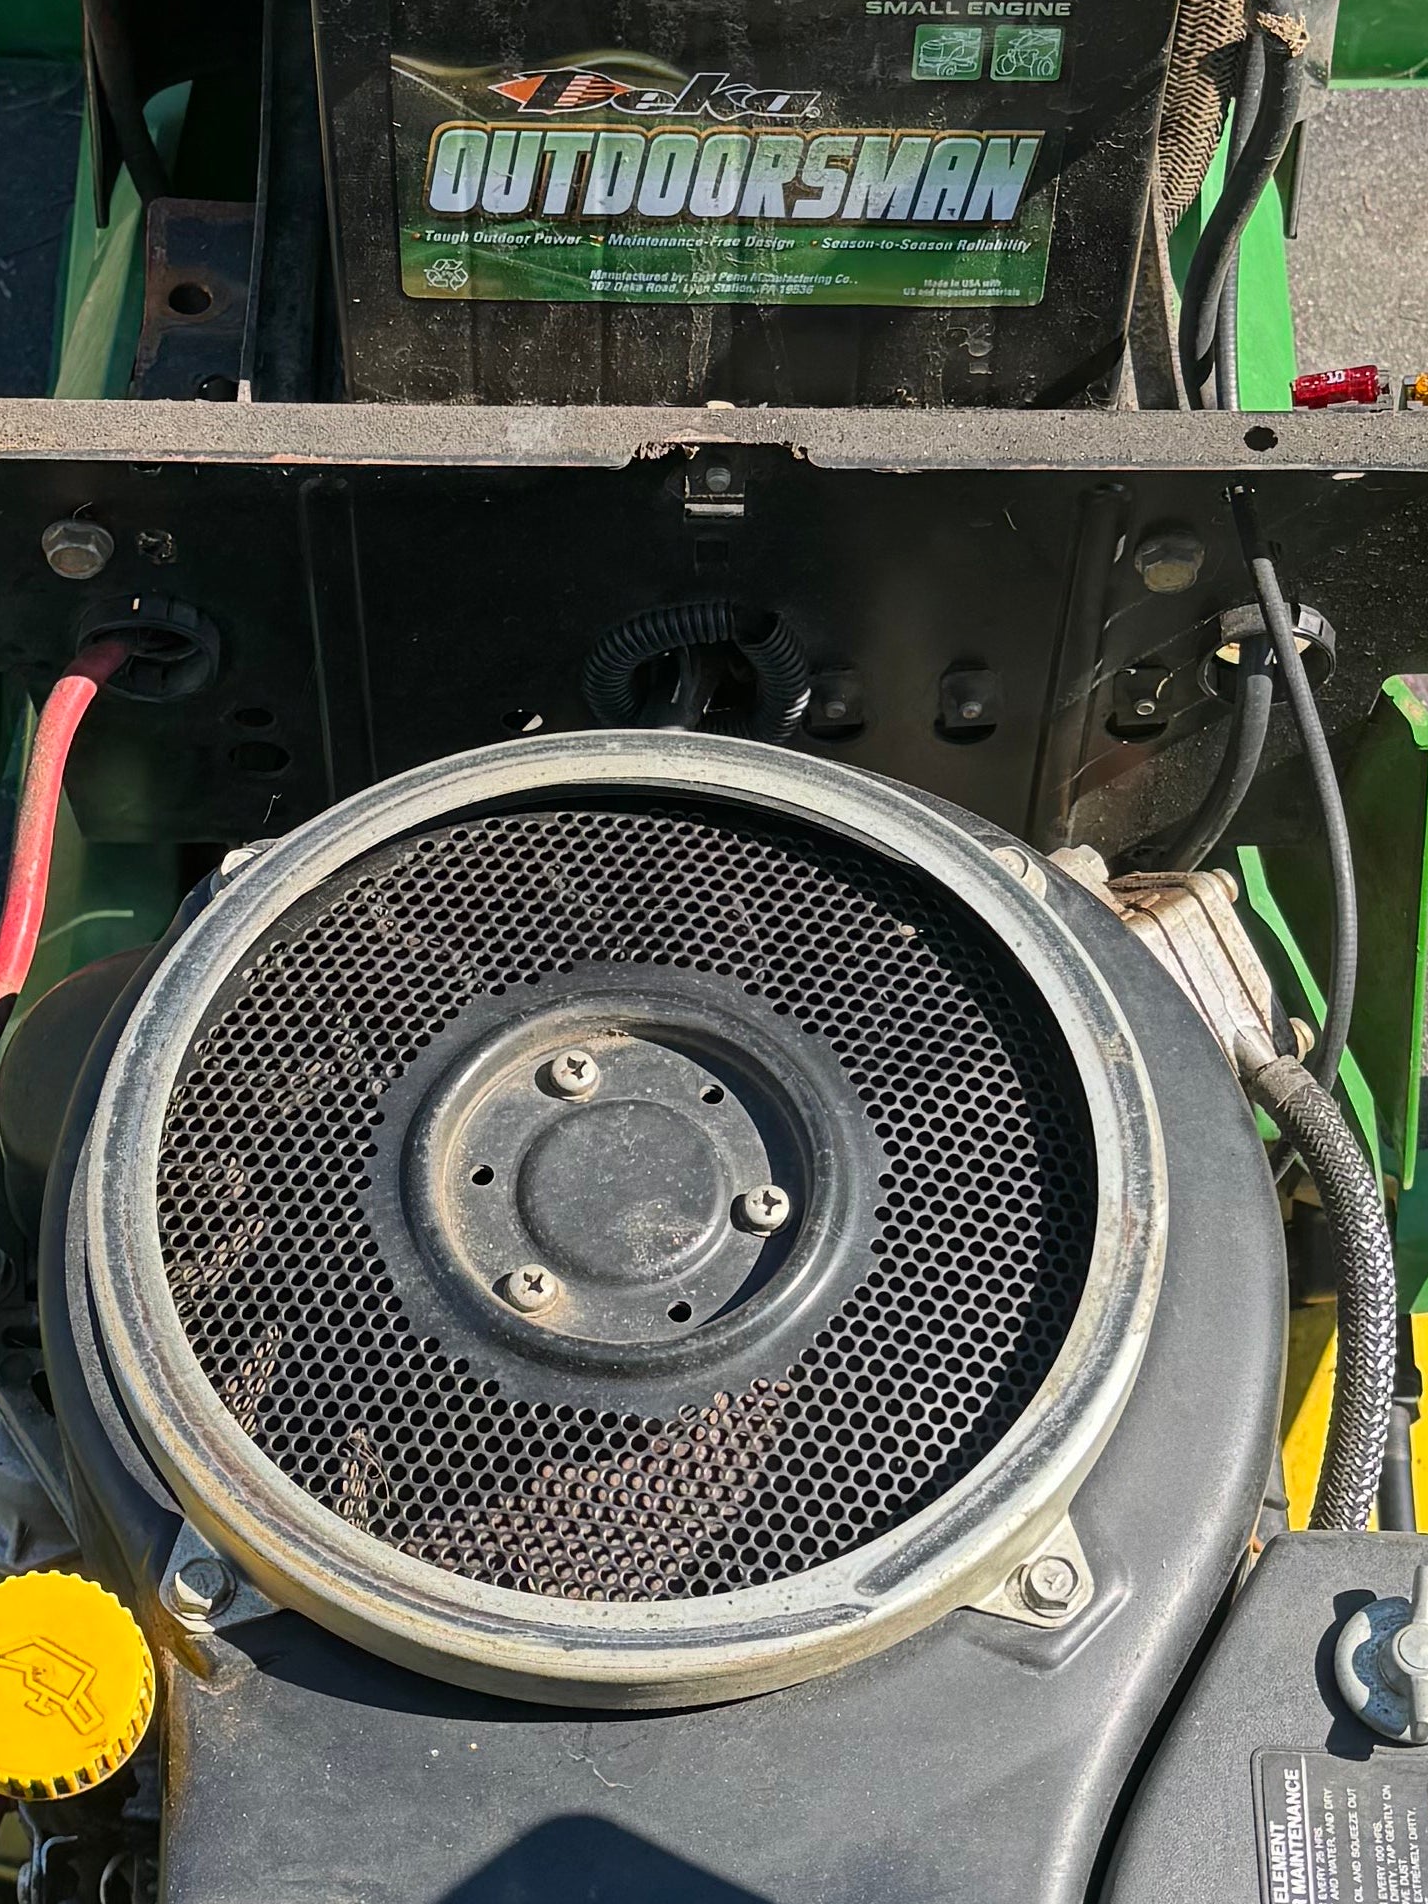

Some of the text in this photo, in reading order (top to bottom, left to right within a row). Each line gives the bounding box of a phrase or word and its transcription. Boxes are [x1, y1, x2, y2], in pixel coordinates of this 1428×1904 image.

[865, 0, 1072, 17] SMALL ENGINE
[490, 66, 814, 121] Deka
[427, 123, 1043, 223] OUTDOORSMAN
[425, 230, 583, 245] Tough Outdoor Power
[745, 236, 796, 250] Design
[822, 237, 1032, 254] Season-to-Season Reliability
[1347, 1788, 1357, 1808] OUT
[1382, 1785, 1392, 1800] ON
[1284, 1768, 1306, 1894] MAINTENANCE
[1348, 1811, 1360, 1858] SQUEEZE
[1383, 1803, 1395, 1842] GENTLY
[1270, 1821, 1289, 1903] ELEMENT
[1352, 1860, 1363, 1883] AND
[1410, 1843, 1423, 1902] EXTREMELY
[1316, 1867, 1328, 1900] EVERY
[1354, 1886, 1364, 1903] OIL
[1376, 1865, 1388, 1900] EVERY
